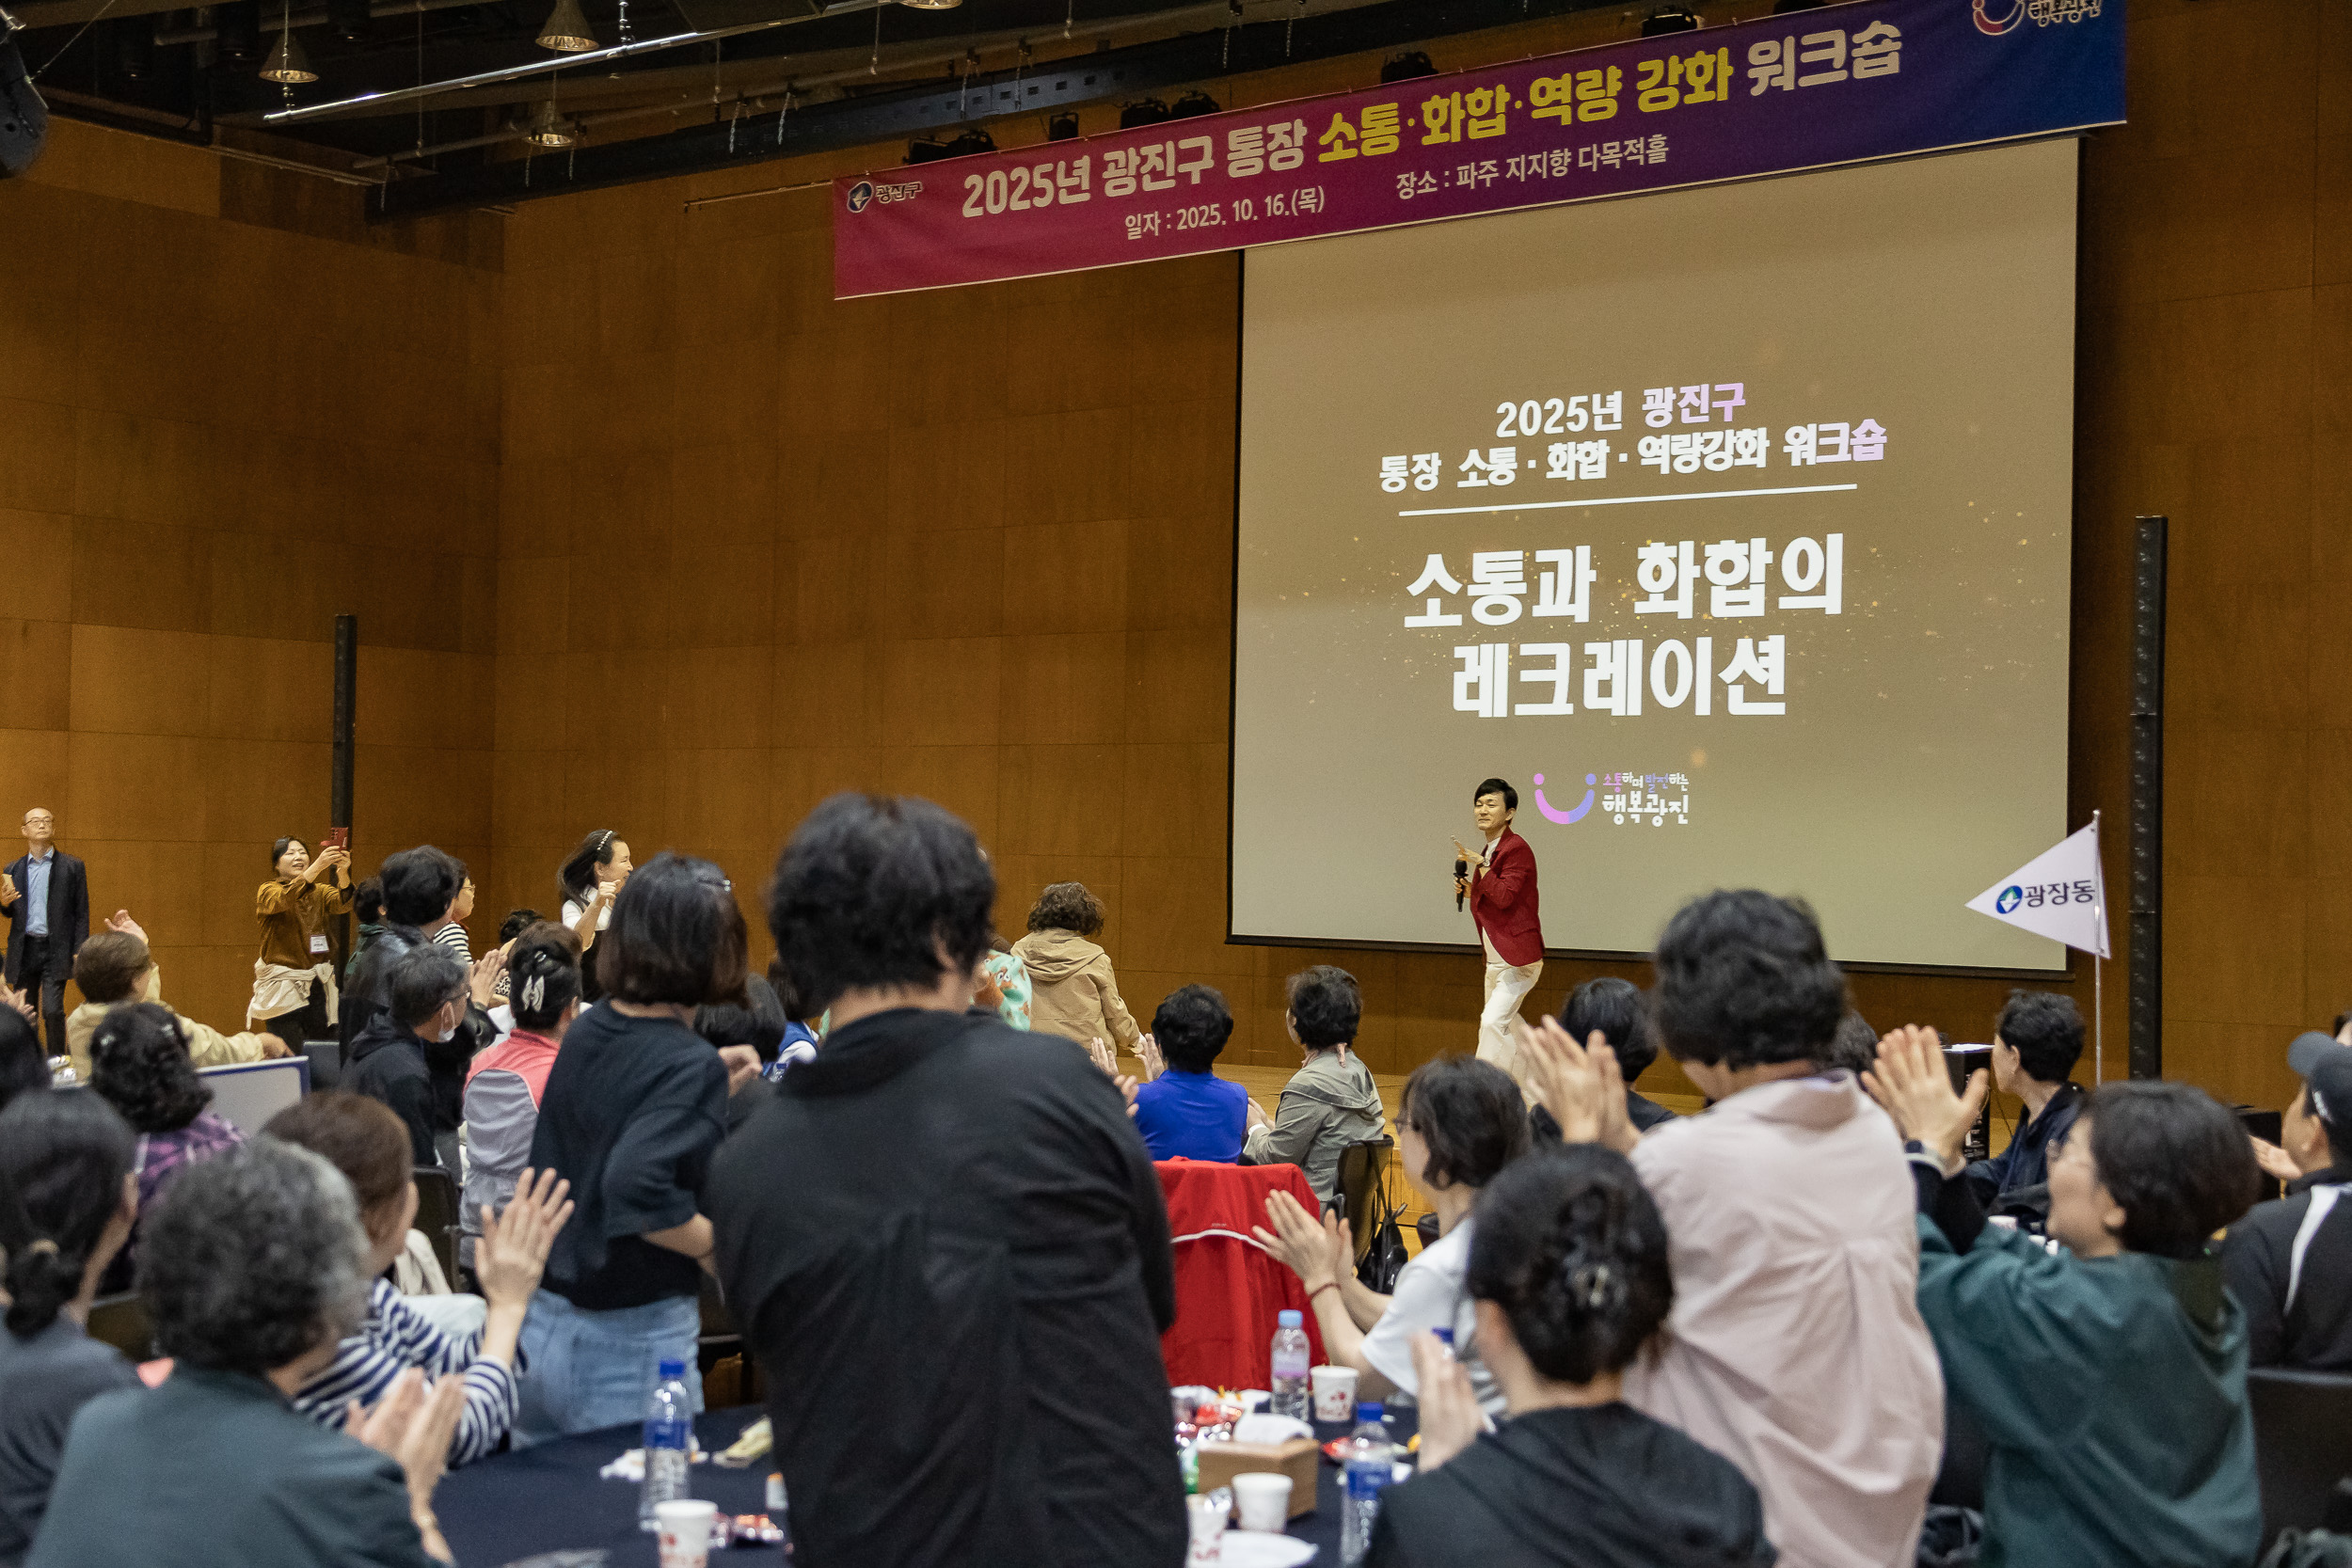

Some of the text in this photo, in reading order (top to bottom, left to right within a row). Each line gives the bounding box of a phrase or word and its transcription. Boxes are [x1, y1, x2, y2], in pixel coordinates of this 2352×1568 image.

[961, 155, 1091, 217] 2025년
[1102, 135, 1215, 197] 광진구
[1227, 119, 1308, 178] 통장
[1636, 48, 1734, 113] 강화
[1747, 20, 1902, 96] 워크숍
[875, 180, 923, 204] 광진구
[1396, 171, 1437, 200] 장소
[1455, 159, 1500, 189] 파주
[1505, 148, 1572, 182] 지지향
[1578, 134, 1670, 172] 다목적홀
[1124, 212, 1162, 240] 일자
[1176, 203, 1227, 230] 2025.
[1232, 198, 1258, 222] 10.
[1264, 185, 1325, 217] 16.(목)
[1496, 382, 1747, 437] 2025년 광진구
[1379, 451, 1441, 492] 통장
[1783, 418, 1888, 467] 워크숍
[1404, 532, 1844, 628] 소통과 화합의
[1452, 634, 1787, 719] 레크레이션
[1601, 790, 1689, 828] 행복광진
[2023, 879, 2096, 909] 광장동
